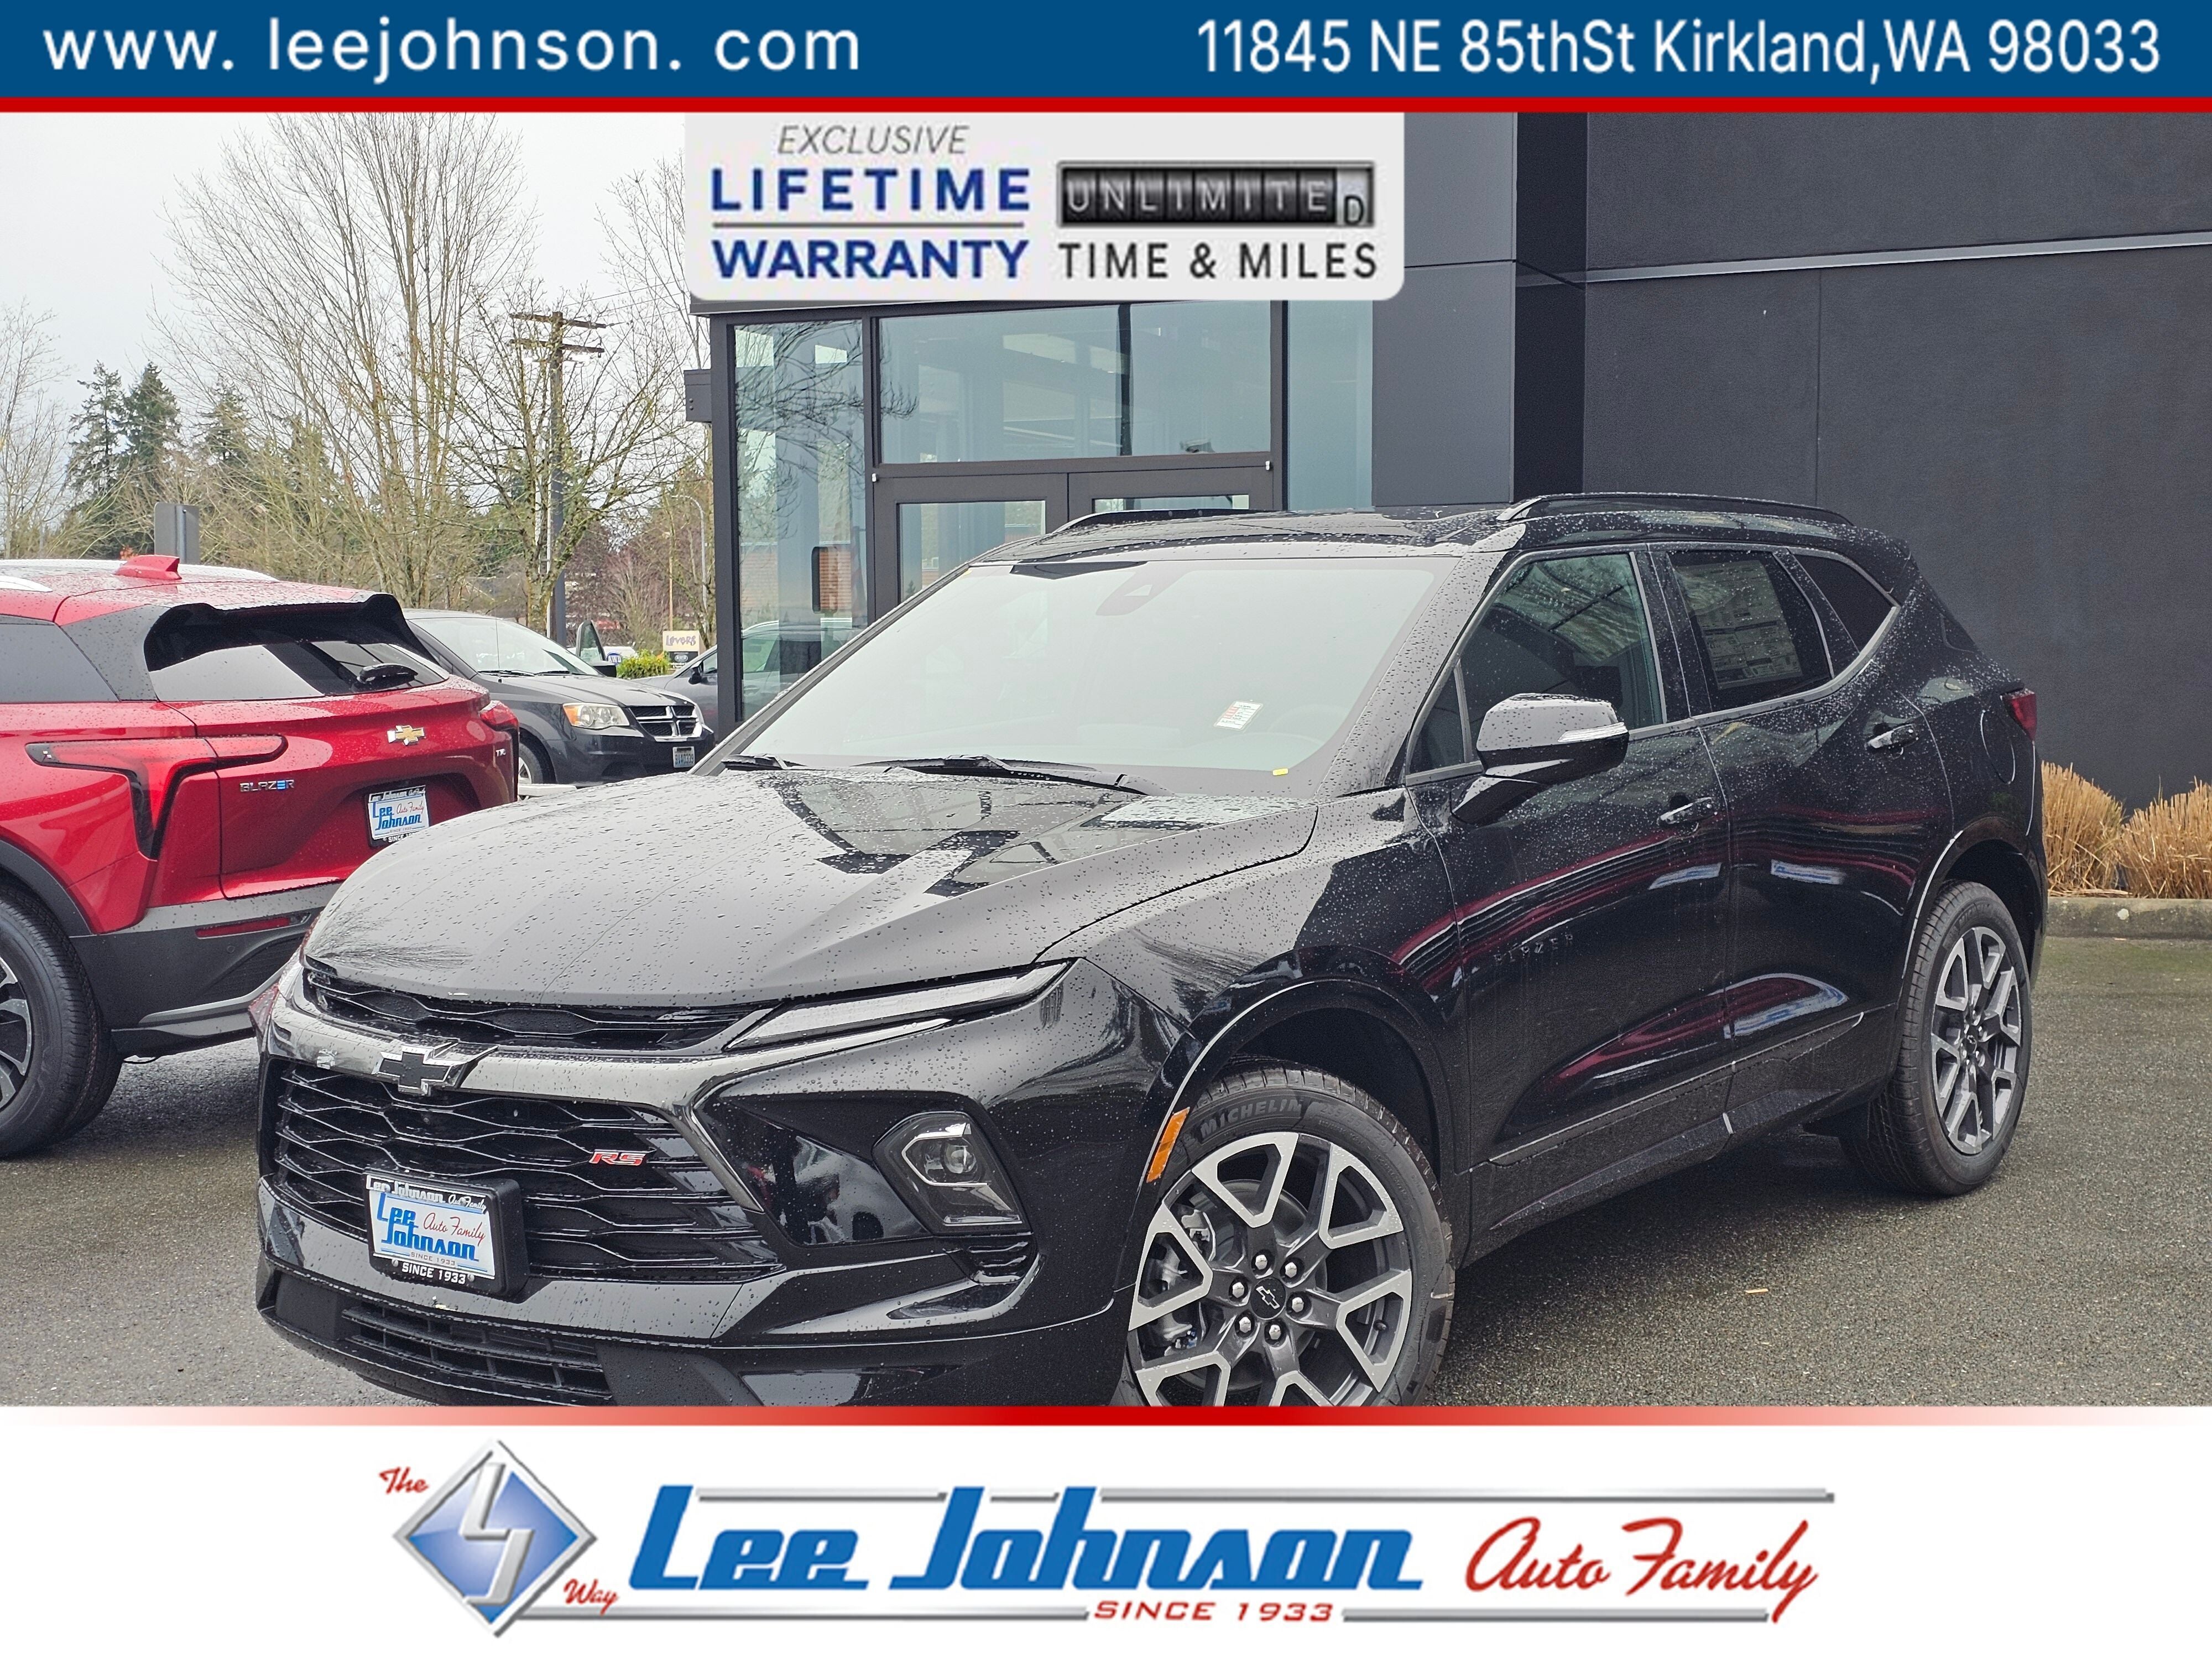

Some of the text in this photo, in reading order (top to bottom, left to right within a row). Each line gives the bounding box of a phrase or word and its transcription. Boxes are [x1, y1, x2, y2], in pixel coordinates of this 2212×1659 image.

[239, 779, 295, 792] BLAZER
[372, 801, 394, 818] Lee
[1200, 1099, 1302, 1140] MICHELIN
[588, 1151, 646, 1166] RS
[377, 1192, 486, 1246] Lee Auto Family
[380, 1219, 479, 1262] Johnson
[411, 1251, 456, 1266] SINCE 1933
[401, 1262, 466, 1285] SINCE 1933
